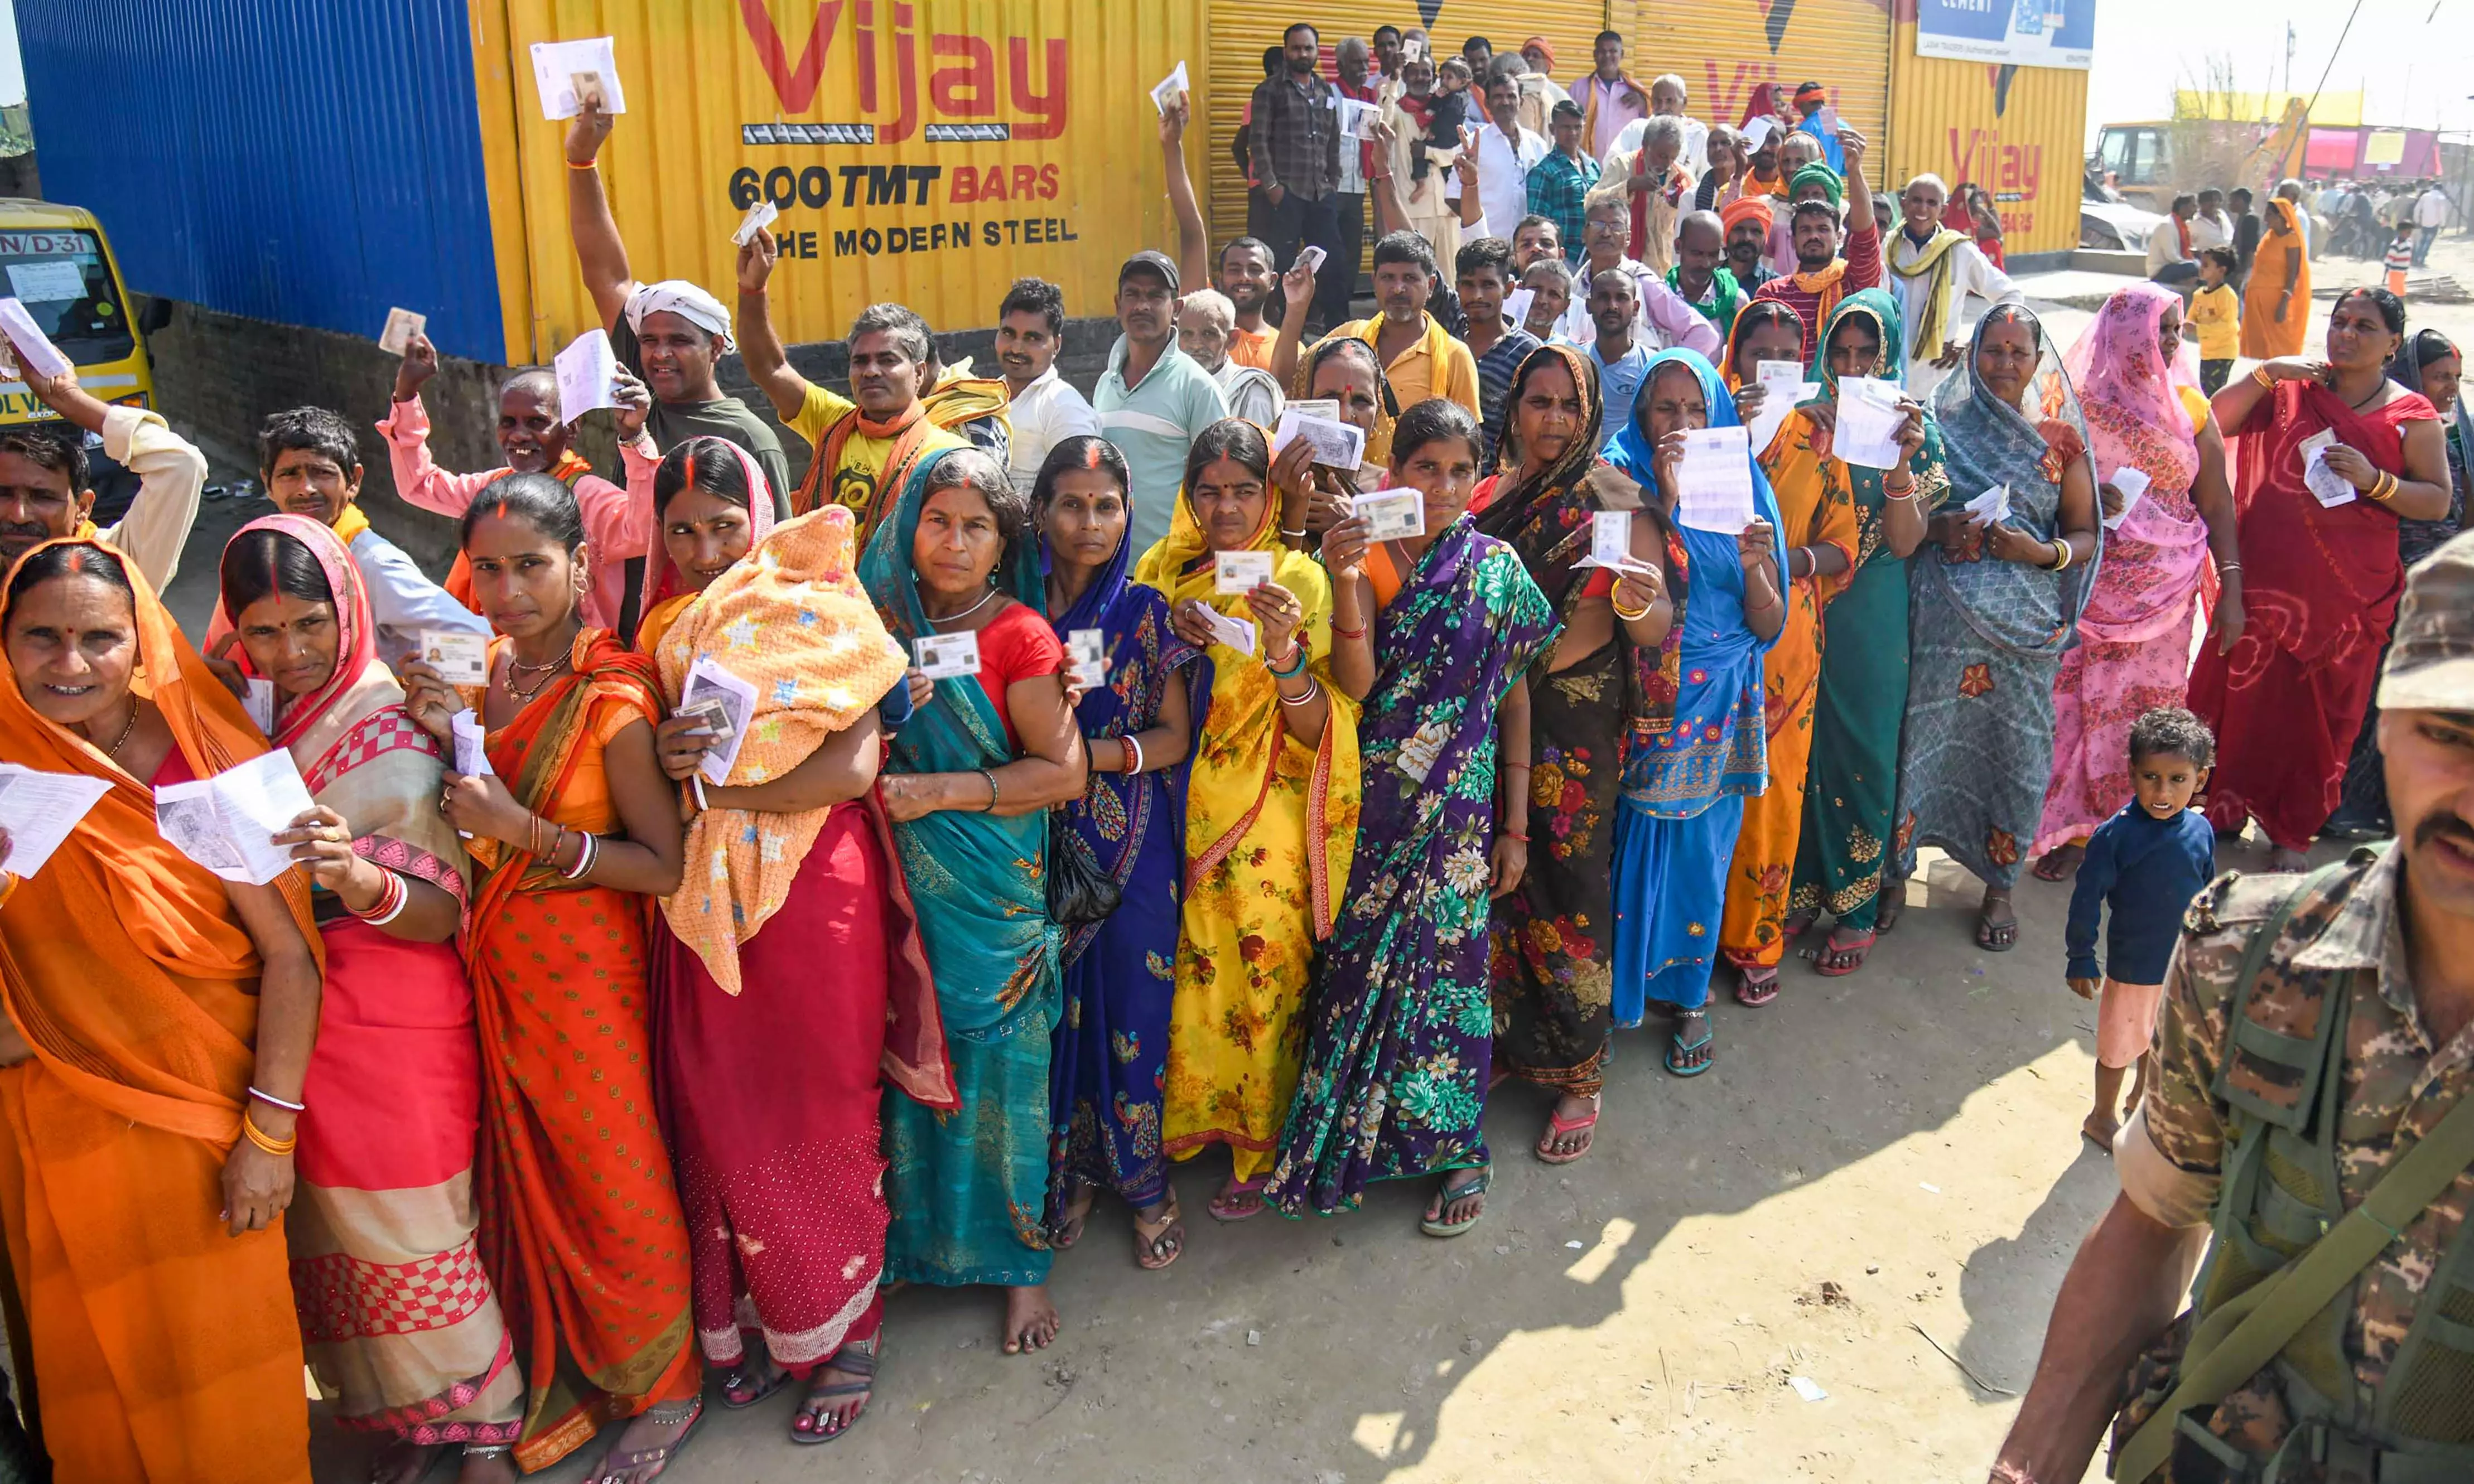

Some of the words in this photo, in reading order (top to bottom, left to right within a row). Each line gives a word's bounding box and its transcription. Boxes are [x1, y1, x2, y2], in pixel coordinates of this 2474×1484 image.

[739, 0, 1066, 144] Vijay
[729, 166, 831, 210] 600
[838, 165, 941, 207] TMT
[949, 163, 1059, 203] BARS
[1949, 128, 2041, 200] Vijay
[776, 230, 818, 259] HE
[835, 222, 970, 257] MODERN
[983, 217, 1078, 246] STEEL
